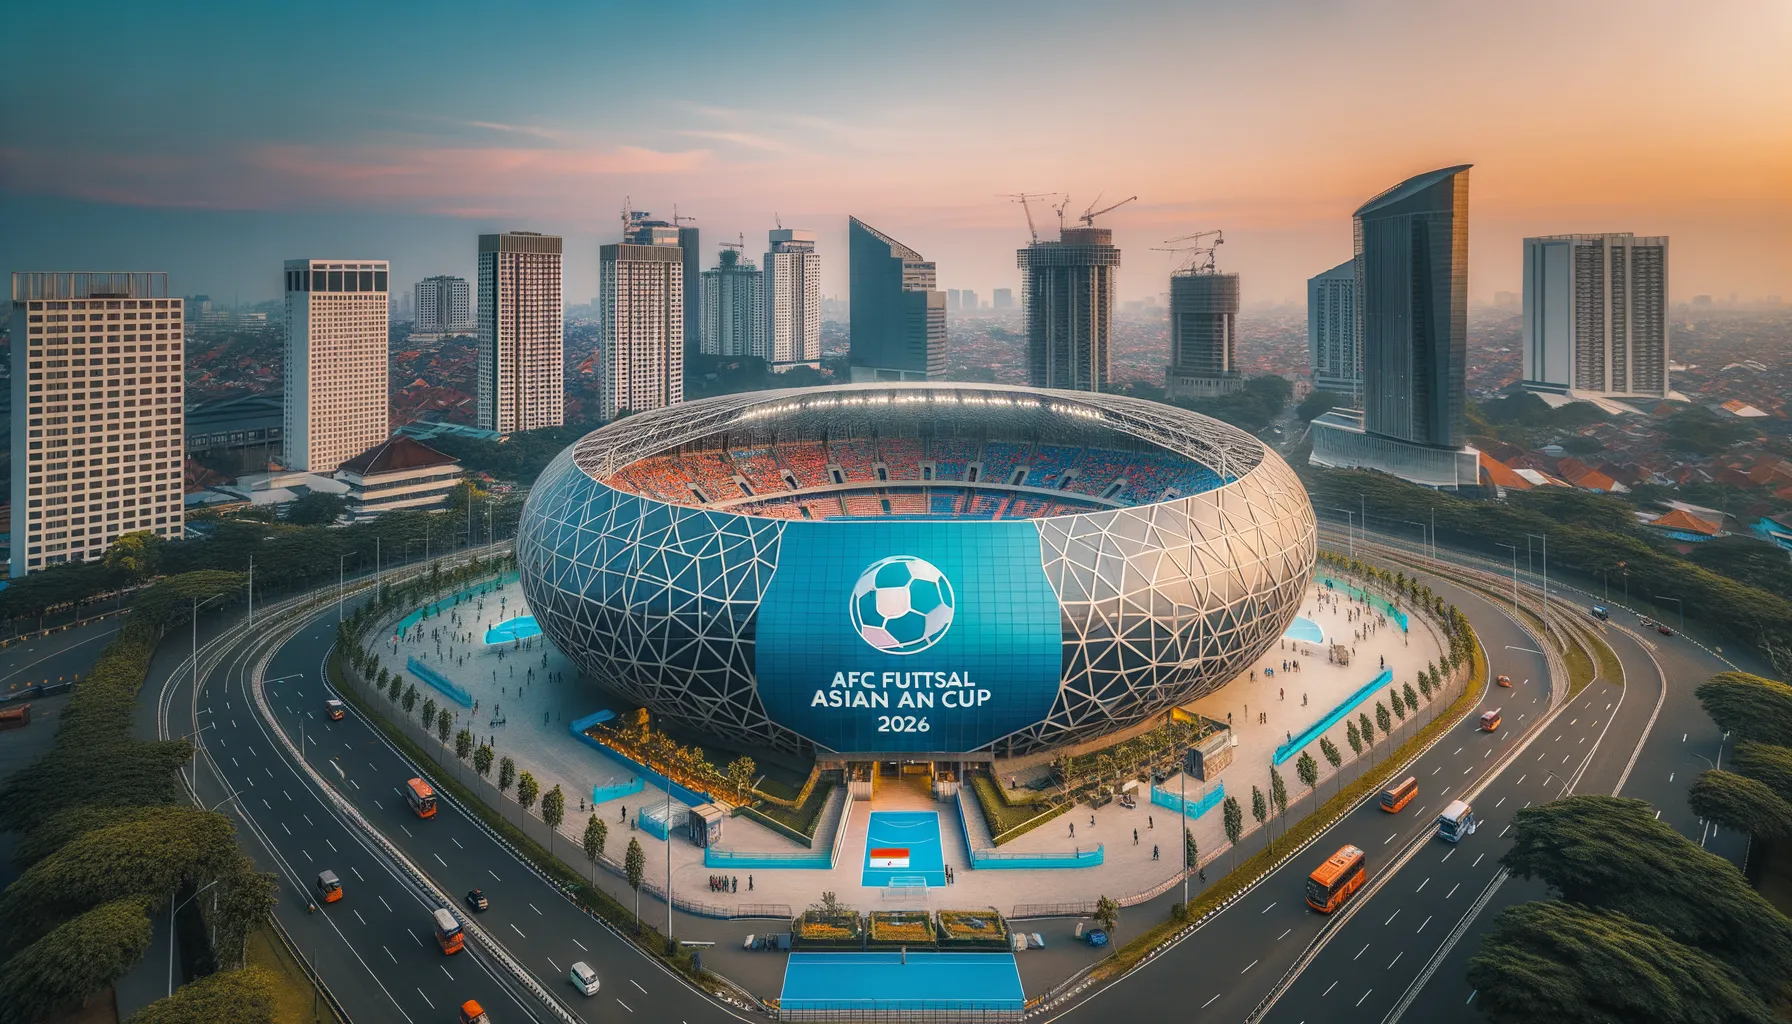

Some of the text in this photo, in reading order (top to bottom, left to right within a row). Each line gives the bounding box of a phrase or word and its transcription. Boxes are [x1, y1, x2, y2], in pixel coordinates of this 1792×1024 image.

[830, 671, 976, 689] AFC FUTTSAL
[810, 689, 991, 709] ASIAN AN CUP
[878, 715, 930, 734] 2026
